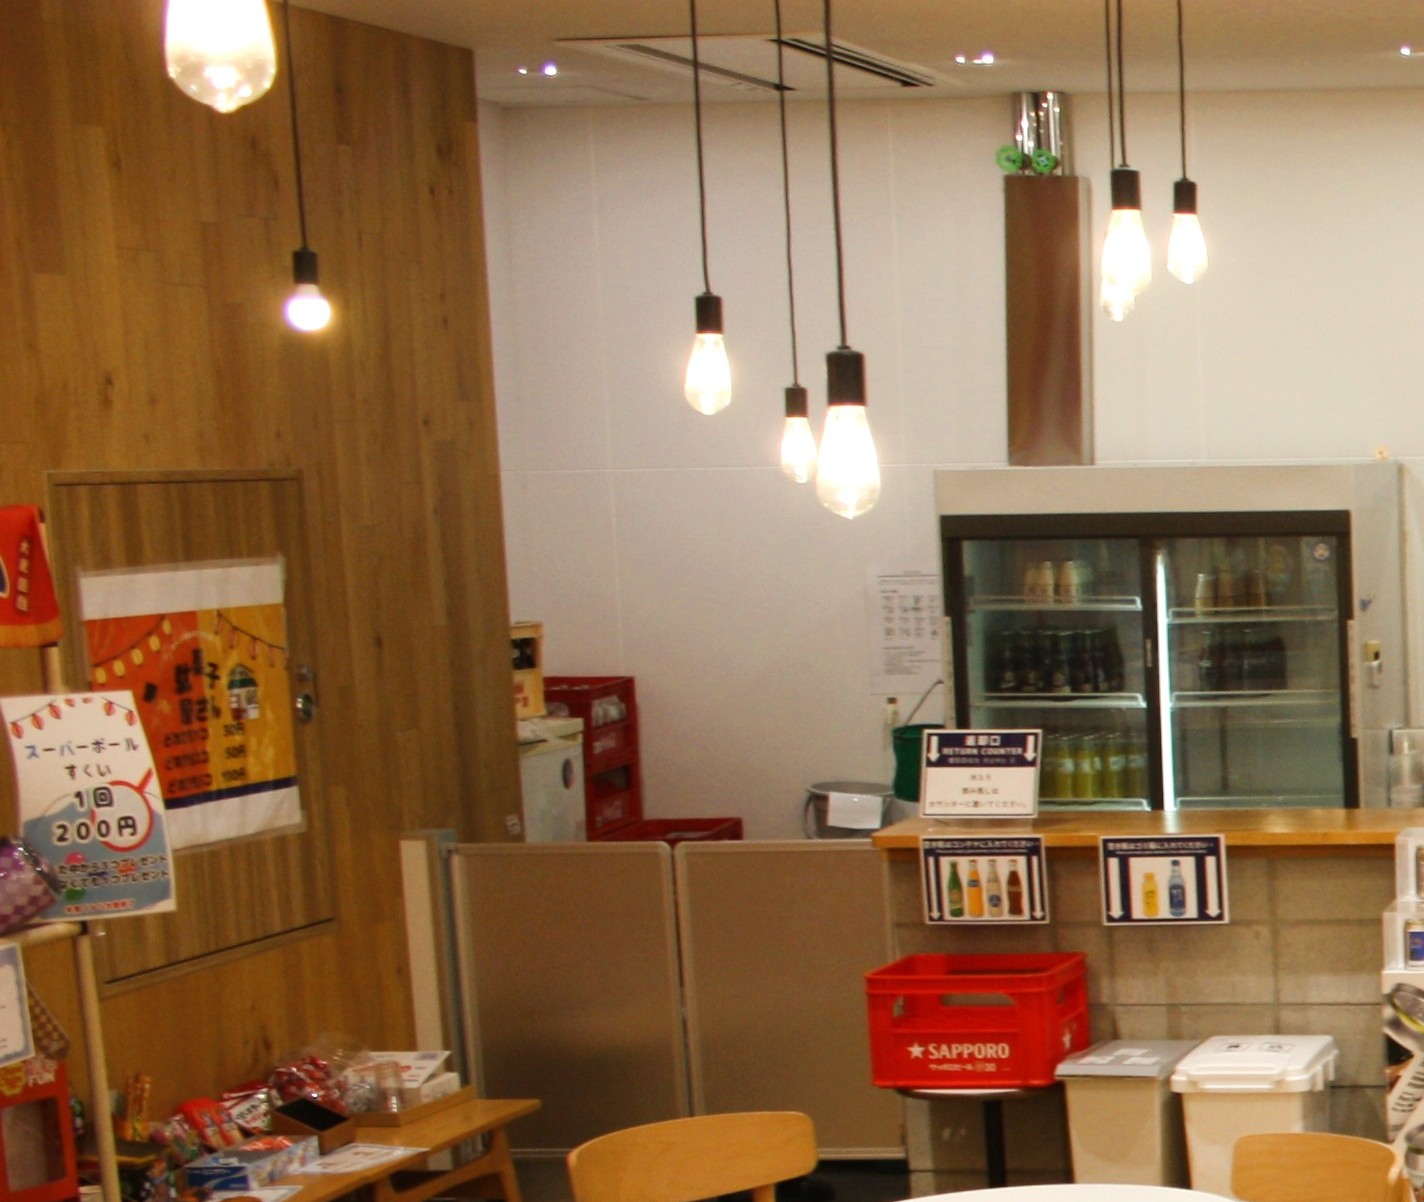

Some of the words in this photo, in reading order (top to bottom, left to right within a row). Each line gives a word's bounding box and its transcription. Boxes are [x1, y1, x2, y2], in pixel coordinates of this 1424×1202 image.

[24, 738, 139, 760] スーパーボール
[64, 763, 113, 780] すくい
[74, 785, 114, 808] 1回
[55, 815, 137, 843] 200円
[927, 1042, 1011, 1060] SAPPORO
